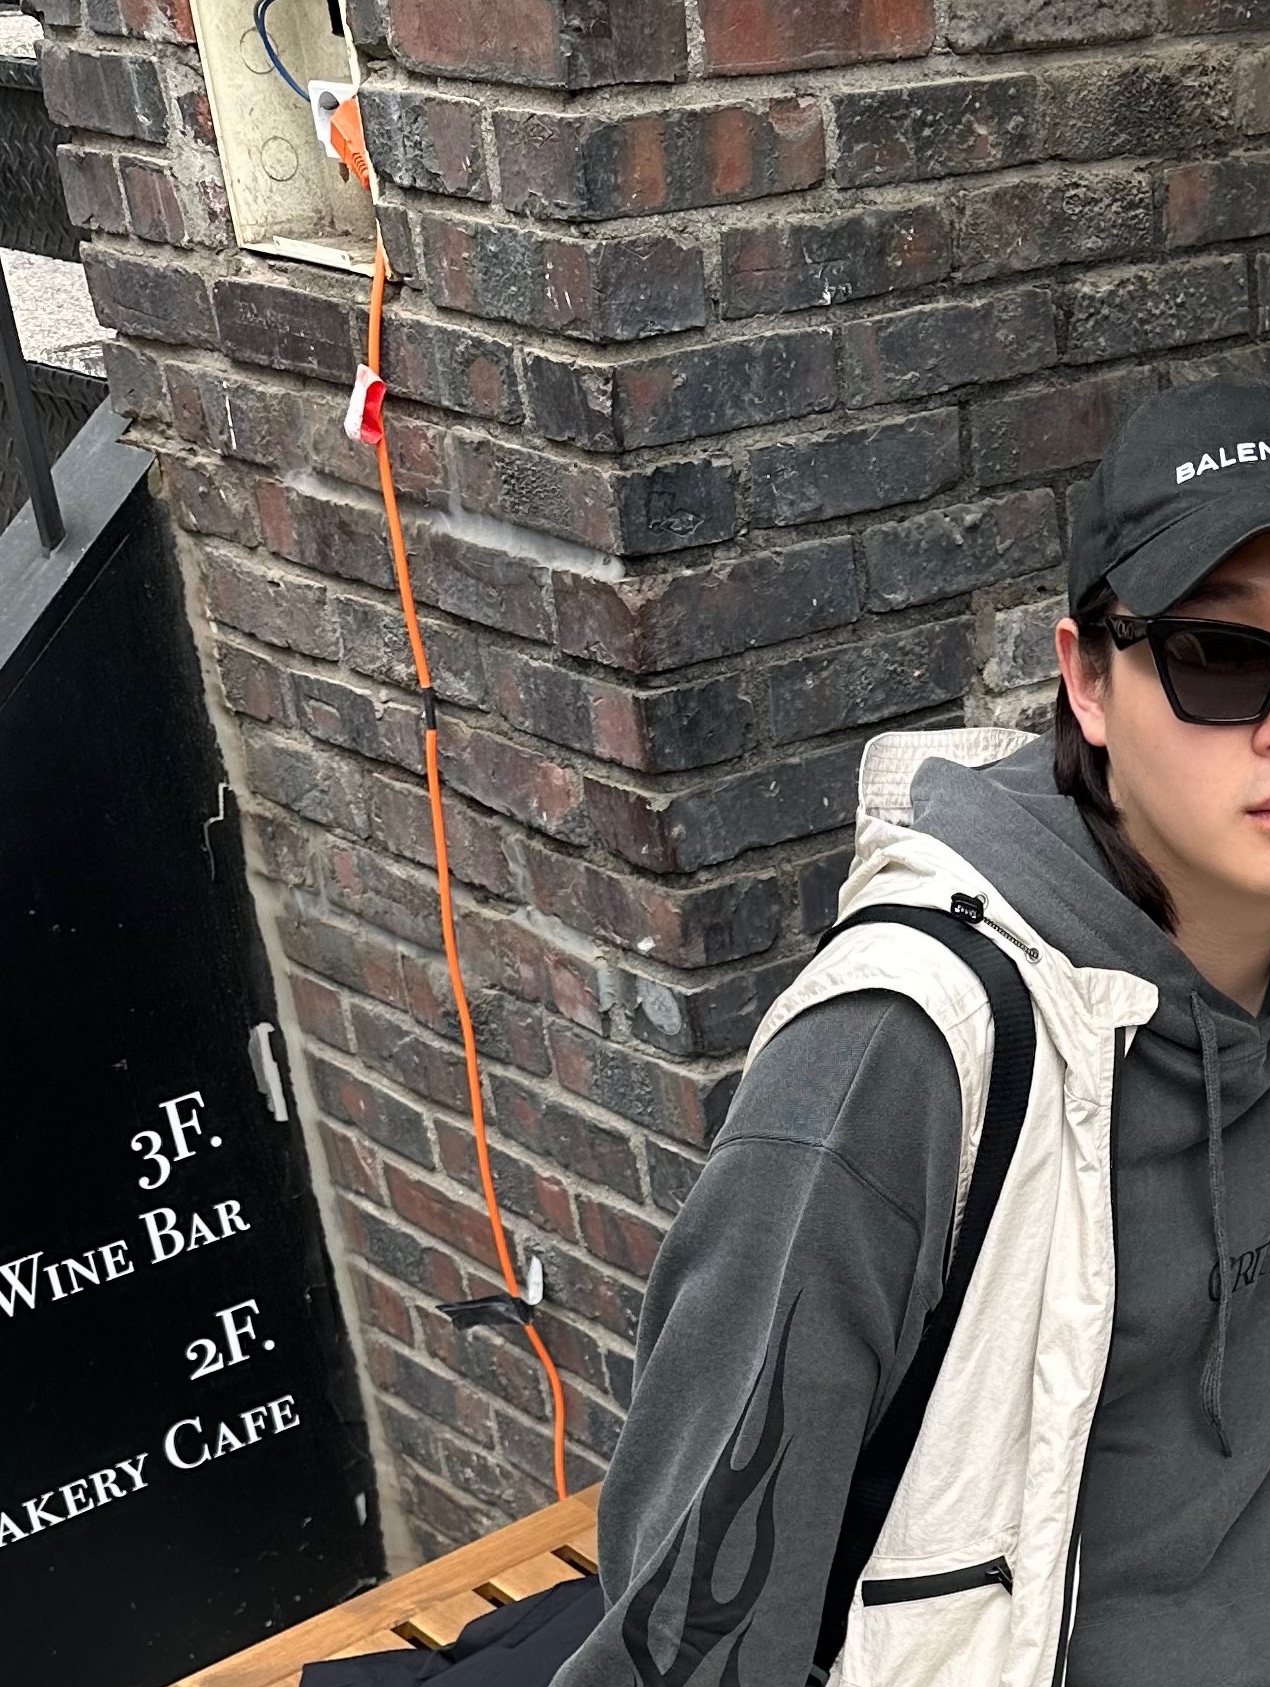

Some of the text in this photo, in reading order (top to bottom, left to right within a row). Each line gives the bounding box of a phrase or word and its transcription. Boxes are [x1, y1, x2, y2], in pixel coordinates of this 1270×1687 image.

[130, 1090, 223, 1190] 3F.
[186, 1298, 275, 1381] 2F.
[0, 1452, 149, 1548] AKERY
